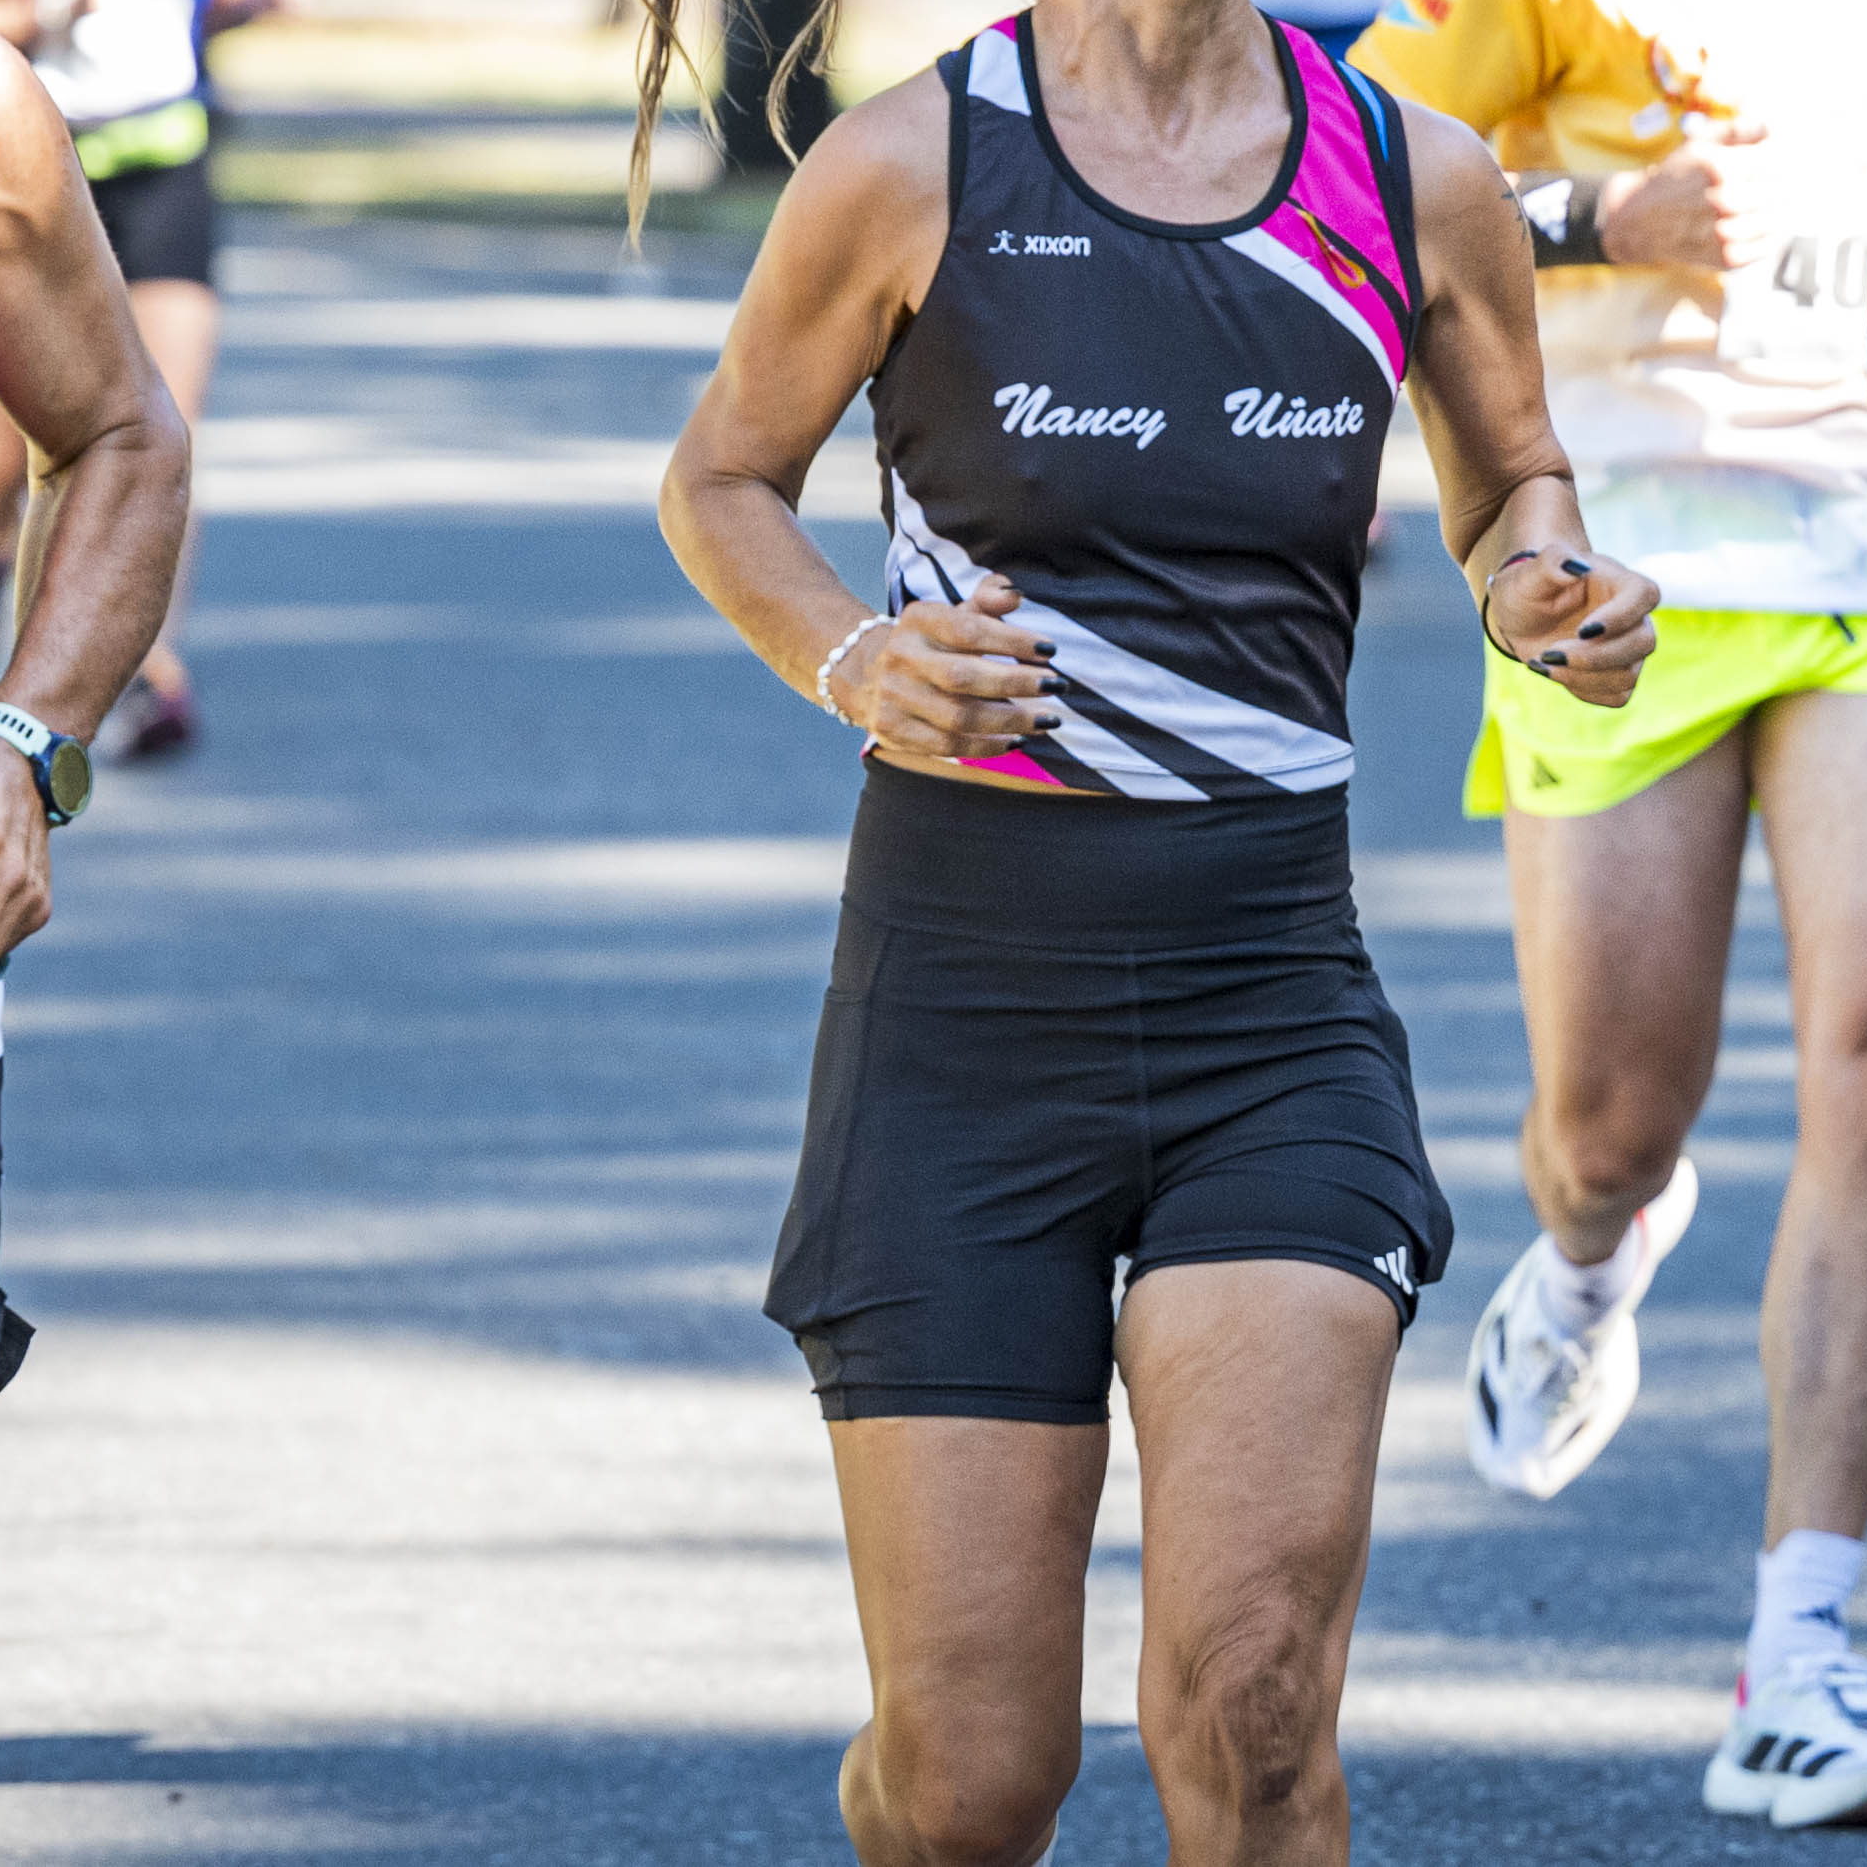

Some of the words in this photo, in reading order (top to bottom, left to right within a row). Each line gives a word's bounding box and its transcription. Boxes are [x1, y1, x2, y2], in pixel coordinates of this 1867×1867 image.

[1023, 234, 1092, 257] xixon
[993, 382, 1167, 451] Nancy
[1224, 386, 1365, 439] Uñate
